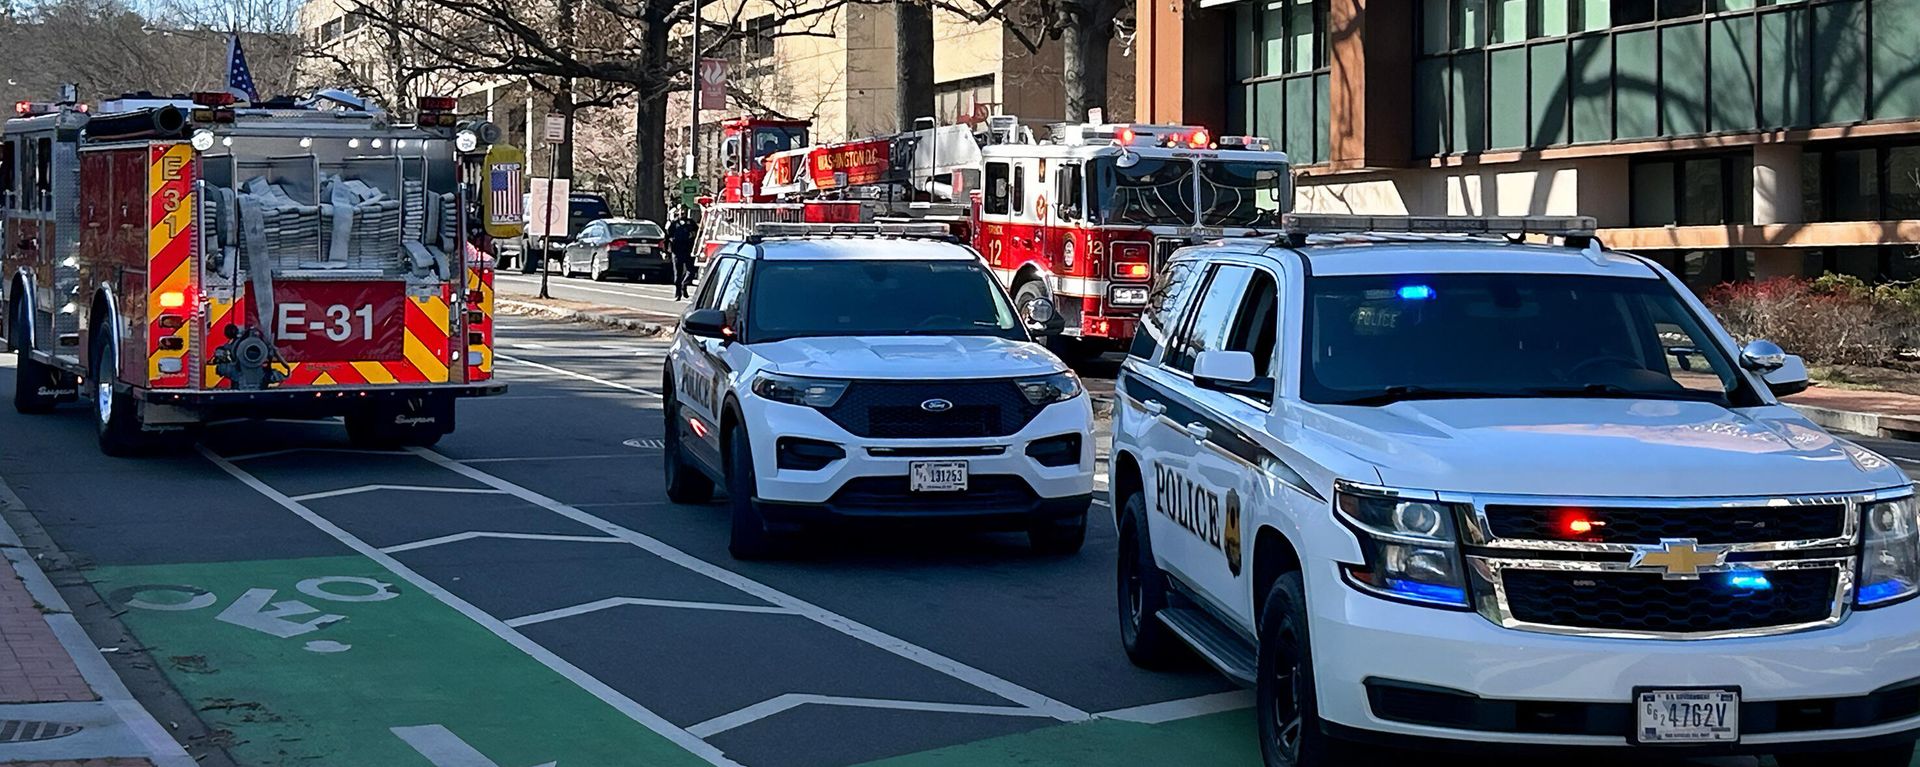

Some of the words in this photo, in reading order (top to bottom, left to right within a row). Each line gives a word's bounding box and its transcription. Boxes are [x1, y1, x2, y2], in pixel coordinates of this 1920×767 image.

[491, 163, 521, 171] KEEP
[817, 150, 865, 171] WASHINGTON
[989, 239, 1002, 266] 12
[1088, 240, 1103, 255] 12
[277, 303, 373, 342] E-31
[1357, 311, 1399, 328] POLICE
[1154, 461, 1222, 552] POLICE
[1668, 702, 1727, 728] 4762V
